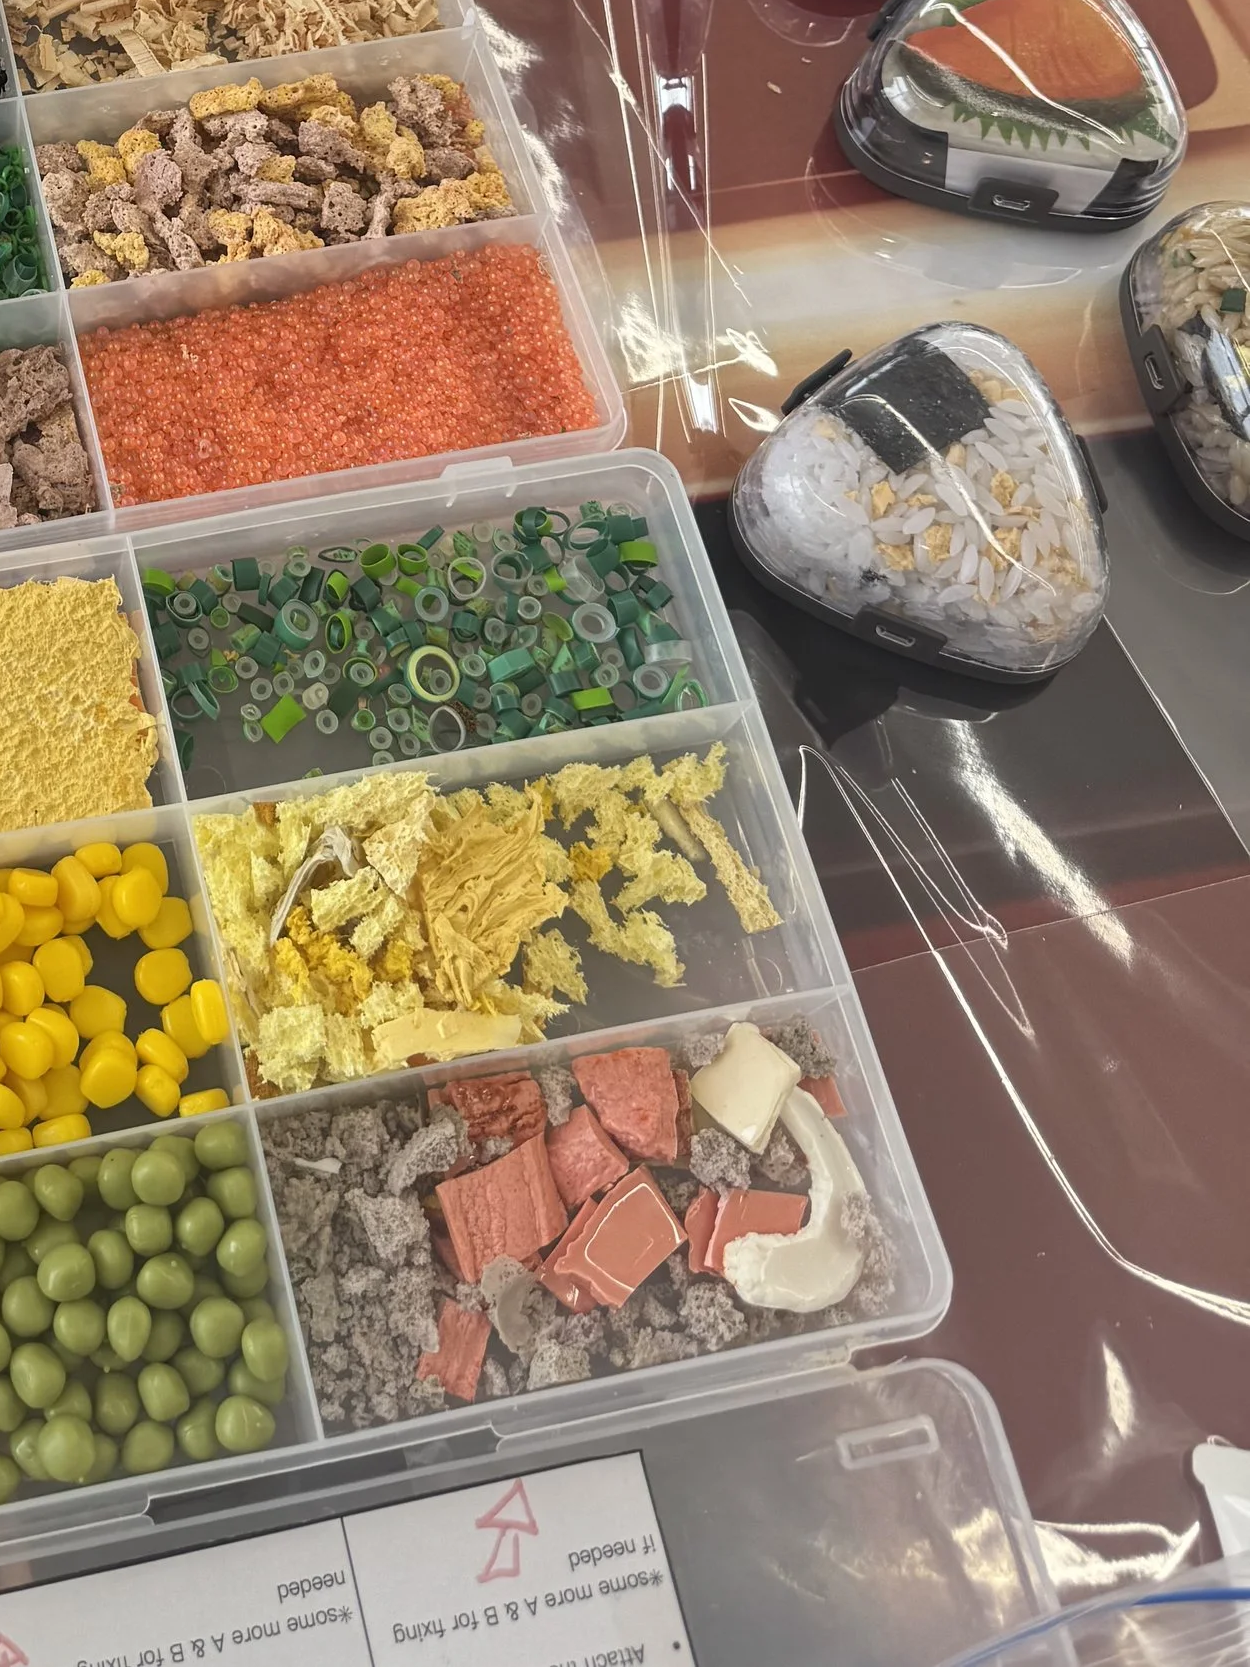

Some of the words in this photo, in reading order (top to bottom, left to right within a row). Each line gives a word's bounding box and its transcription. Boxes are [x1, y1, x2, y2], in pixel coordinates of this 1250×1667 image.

[567, 1538, 637, 1573] needed
[642, 1533, 657, 1556] if
[276, 1570, 347, 1605] needed
[544, 1583, 594, 1608] more
[483, 1605, 500, 1627] B
[503, 1601, 520, 1622] &
[523, 1595, 538, 1617] A
[392, 1618, 447, 1644] fixing
[451, 1610, 480, 1631] for
[210, 1632, 225, 1654] A
[231, 1620, 281, 1645] more
[136, 1647, 165, 1667] for
[169, 1642, 185, 1664] B
[190, 1638, 205, 1659] &
